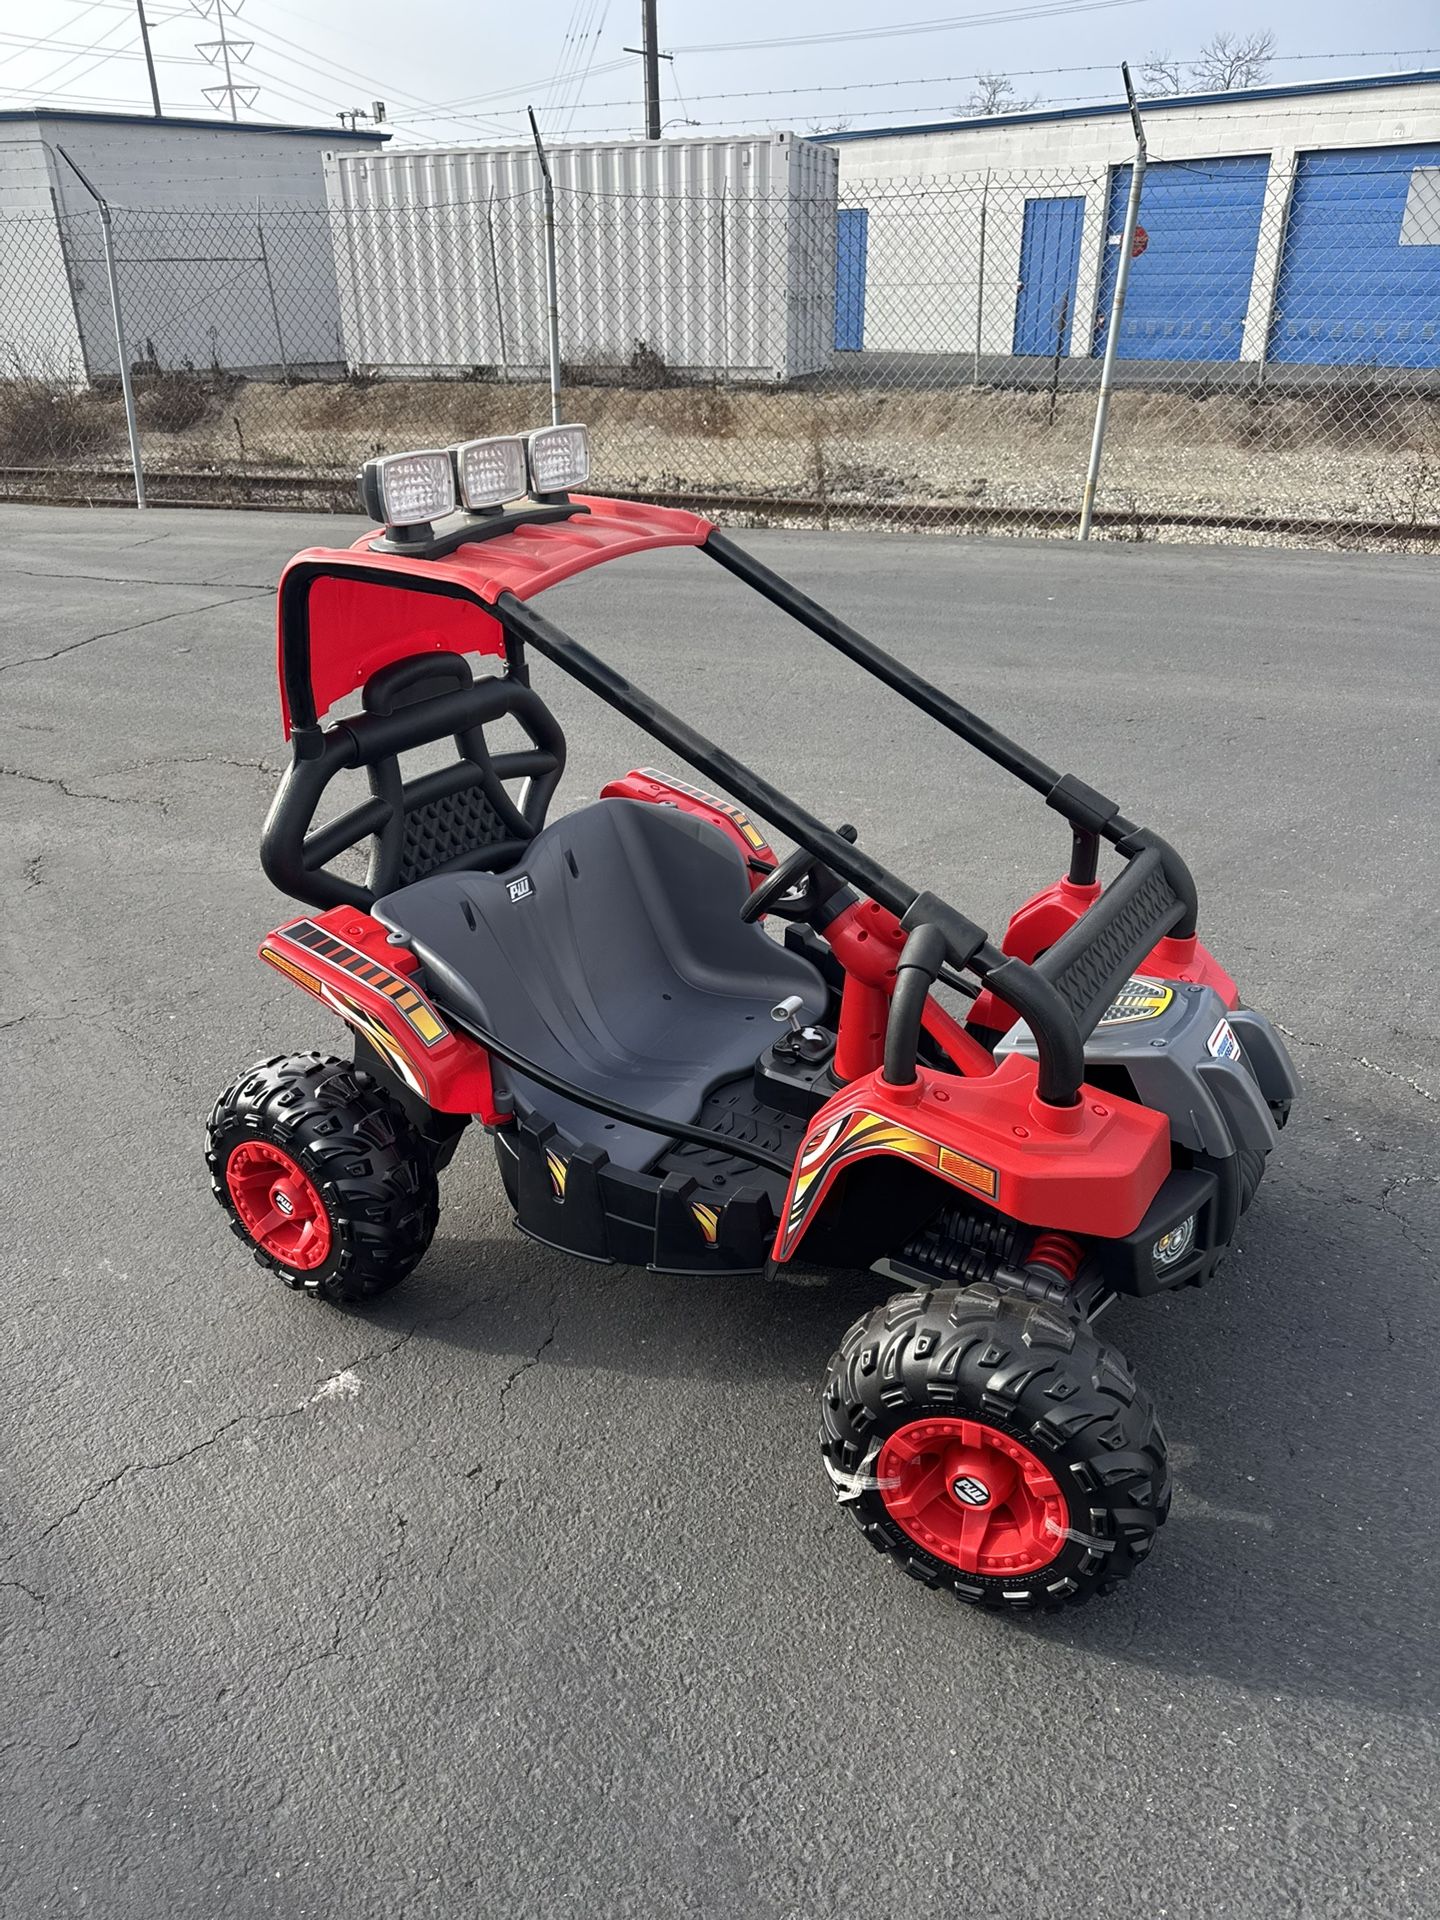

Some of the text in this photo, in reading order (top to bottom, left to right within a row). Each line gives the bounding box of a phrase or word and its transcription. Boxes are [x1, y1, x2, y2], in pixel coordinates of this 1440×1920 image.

[509, 878, 530, 900] PW
[275, 1193, 294, 1212] PW
[955, 1478, 988, 1503] PW
